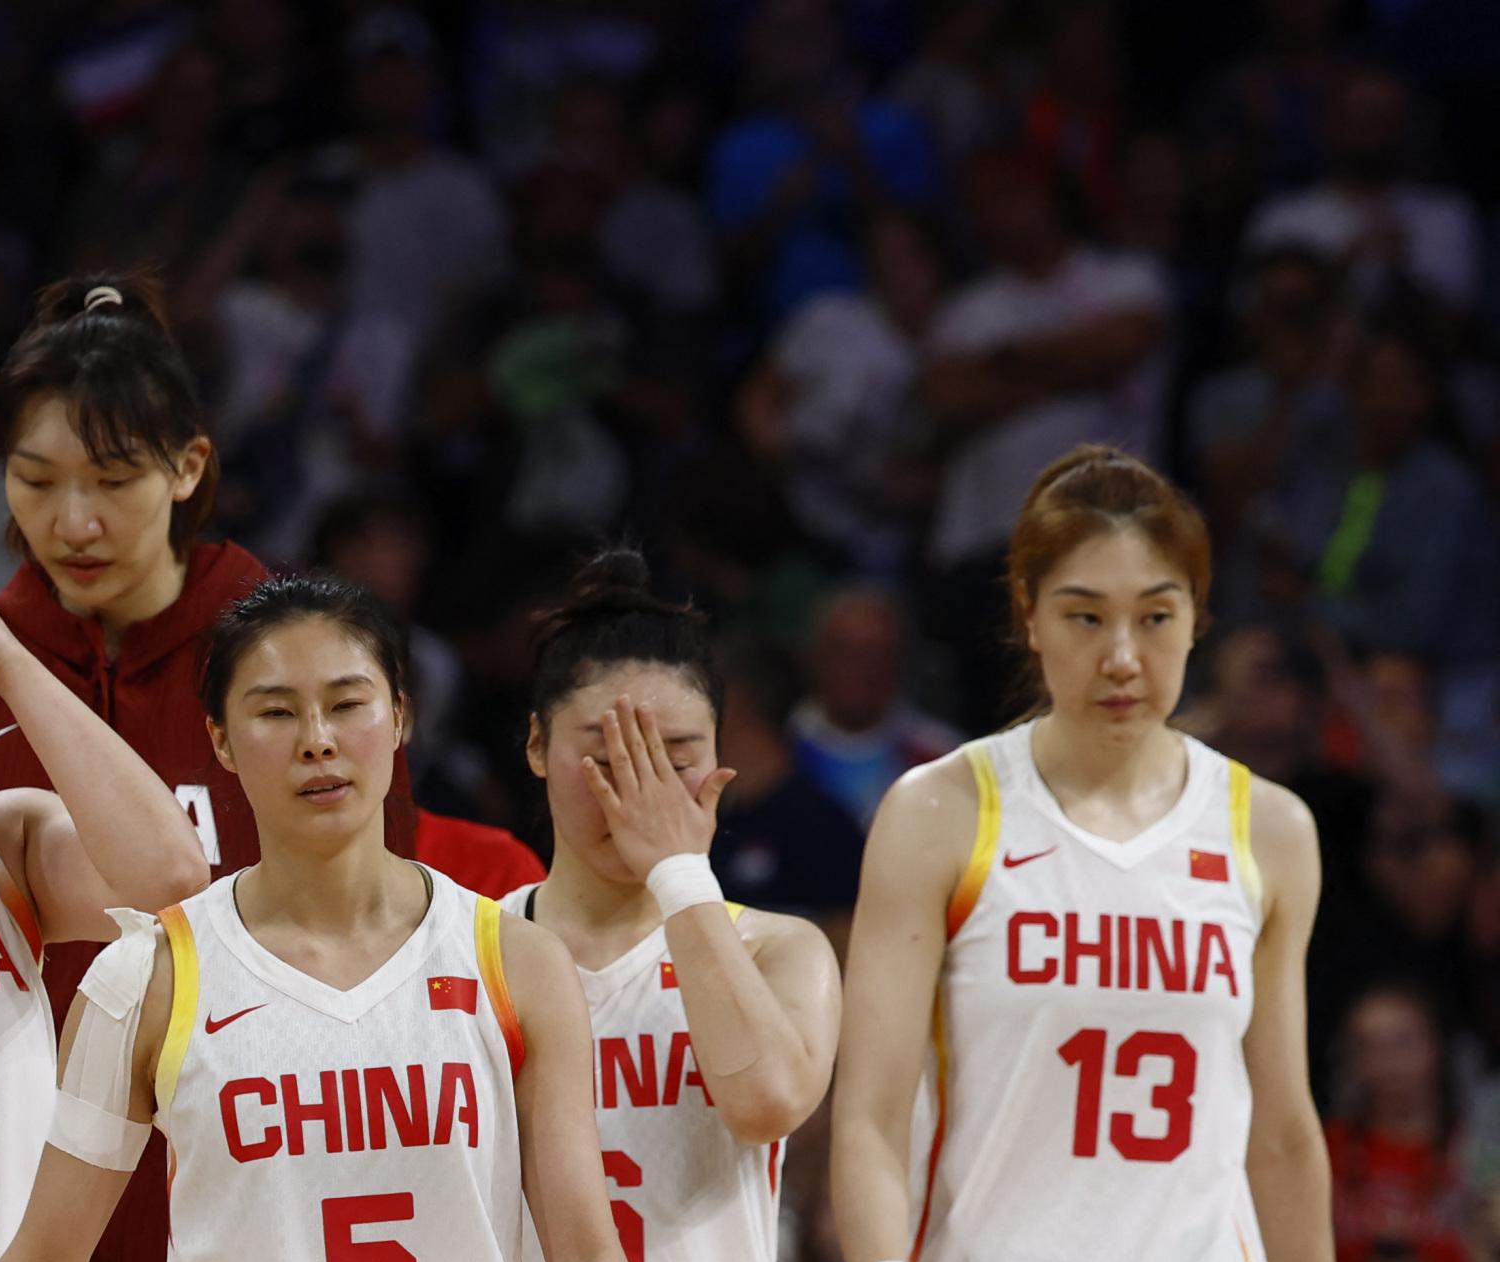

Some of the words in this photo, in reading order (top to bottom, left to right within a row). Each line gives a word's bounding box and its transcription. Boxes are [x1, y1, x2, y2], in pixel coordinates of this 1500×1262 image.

[1007, 911, 1239, 998] CHINA
[218, 1061, 480, 1165] CHINA
[1057, 1027, 1198, 1164] 13
